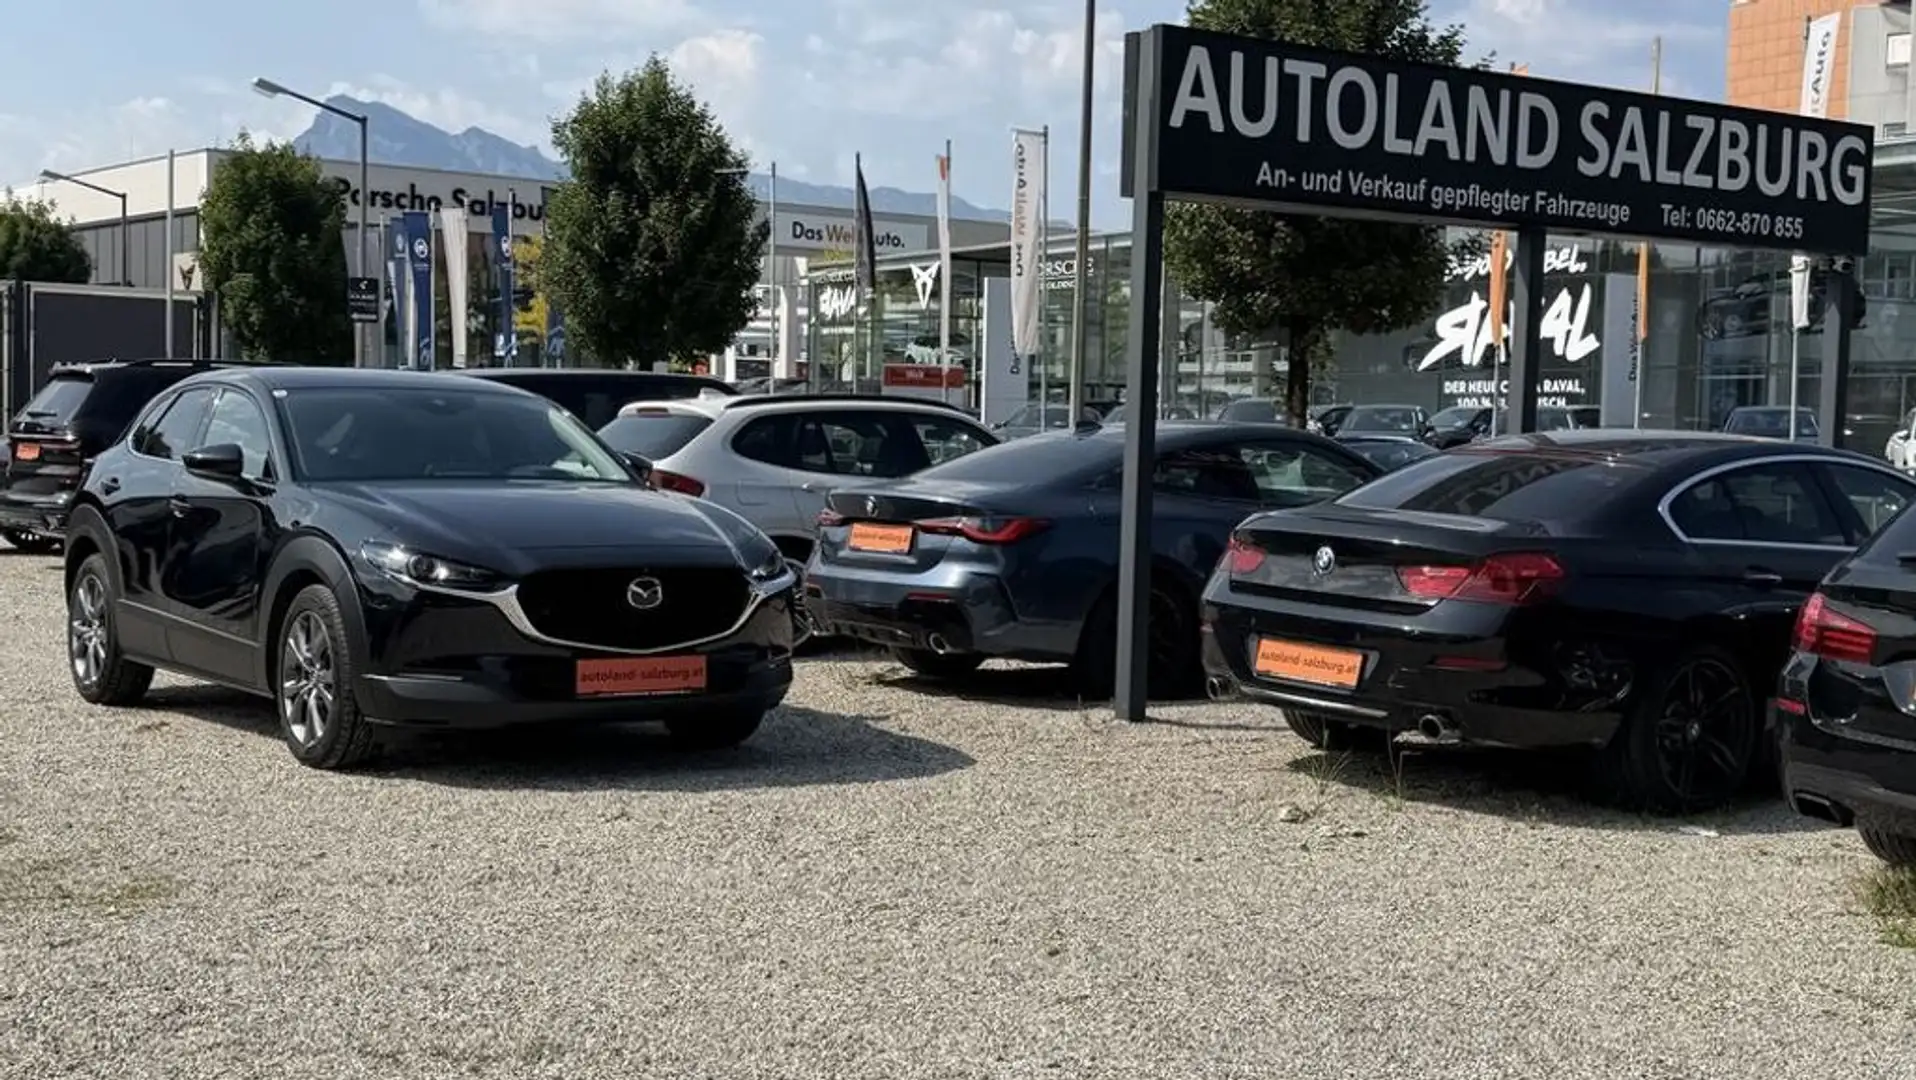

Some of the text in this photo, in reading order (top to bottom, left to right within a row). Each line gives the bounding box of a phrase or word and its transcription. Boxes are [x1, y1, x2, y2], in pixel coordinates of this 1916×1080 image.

[1169, 45, 1866, 205] AUTOLAND SALZBURG
[1256, 161, 1630, 226] An- und Verkauf gepflegter Fahrzeuge
[792, 221, 823, 240] Das
[1661, 204, 1803, 239] Tel: 0662-870 855
[1444, 381, 1466, 394] DER
[1260, 651, 1357, 674] autoland-salzburg.at
